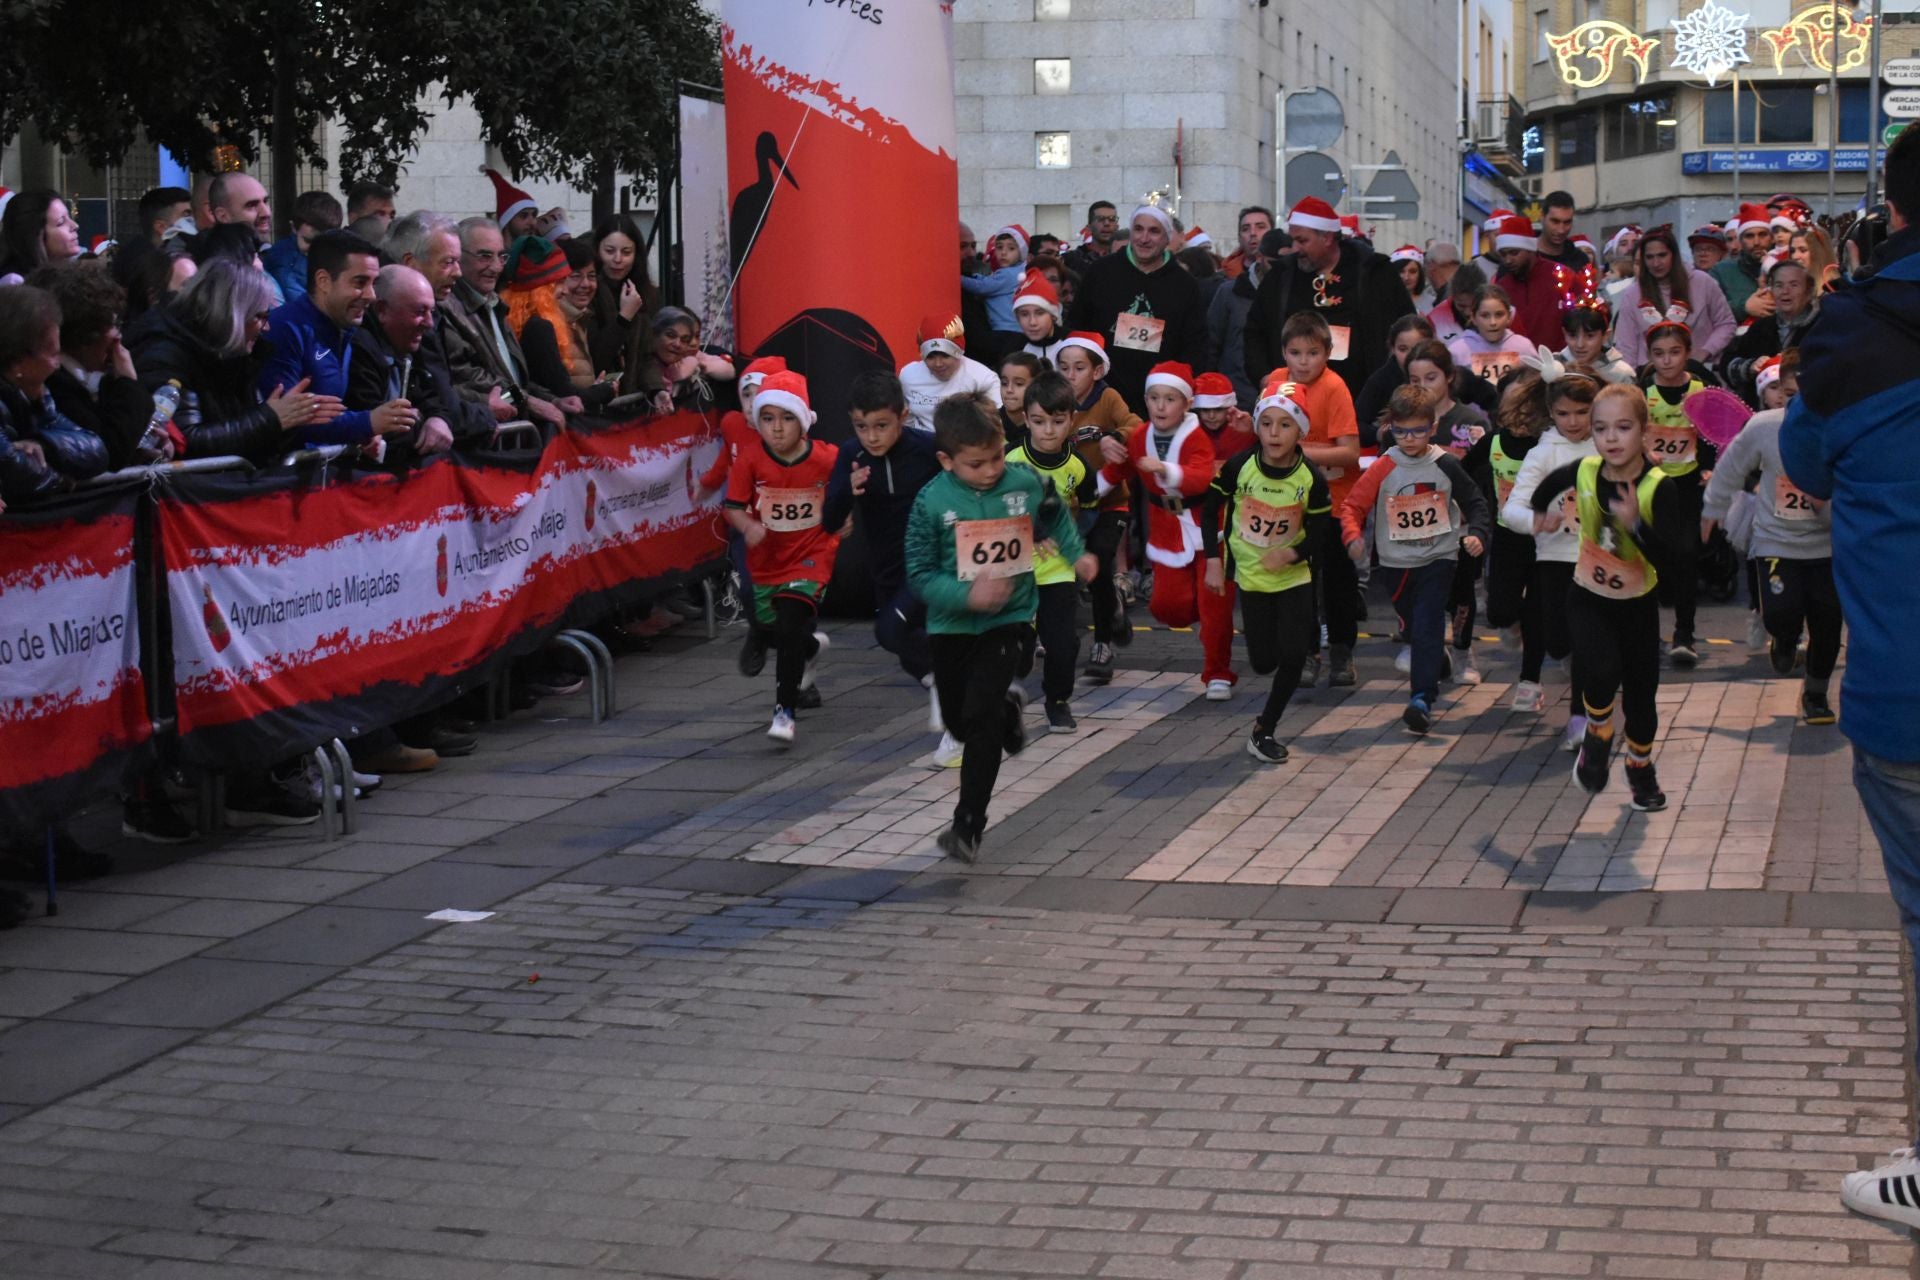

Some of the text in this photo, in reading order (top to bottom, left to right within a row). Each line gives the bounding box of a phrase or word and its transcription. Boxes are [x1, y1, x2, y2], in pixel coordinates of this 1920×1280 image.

[1128, 327, 1149, 342] 28
[1653, 438, 1689, 454] 267
[771, 503, 813, 520] 582
[1397, 507, 1438, 529] 382
[1249, 515, 1289, 537] 375
[972, 538, 1021, 565] 620
[1765, 558, 1779, 574] 7
[1592, 566, 1624, 590] 86
[230, 569, 400, 635] Ayuntamiento de Miajadas
[18, 628, 45, 662] de
